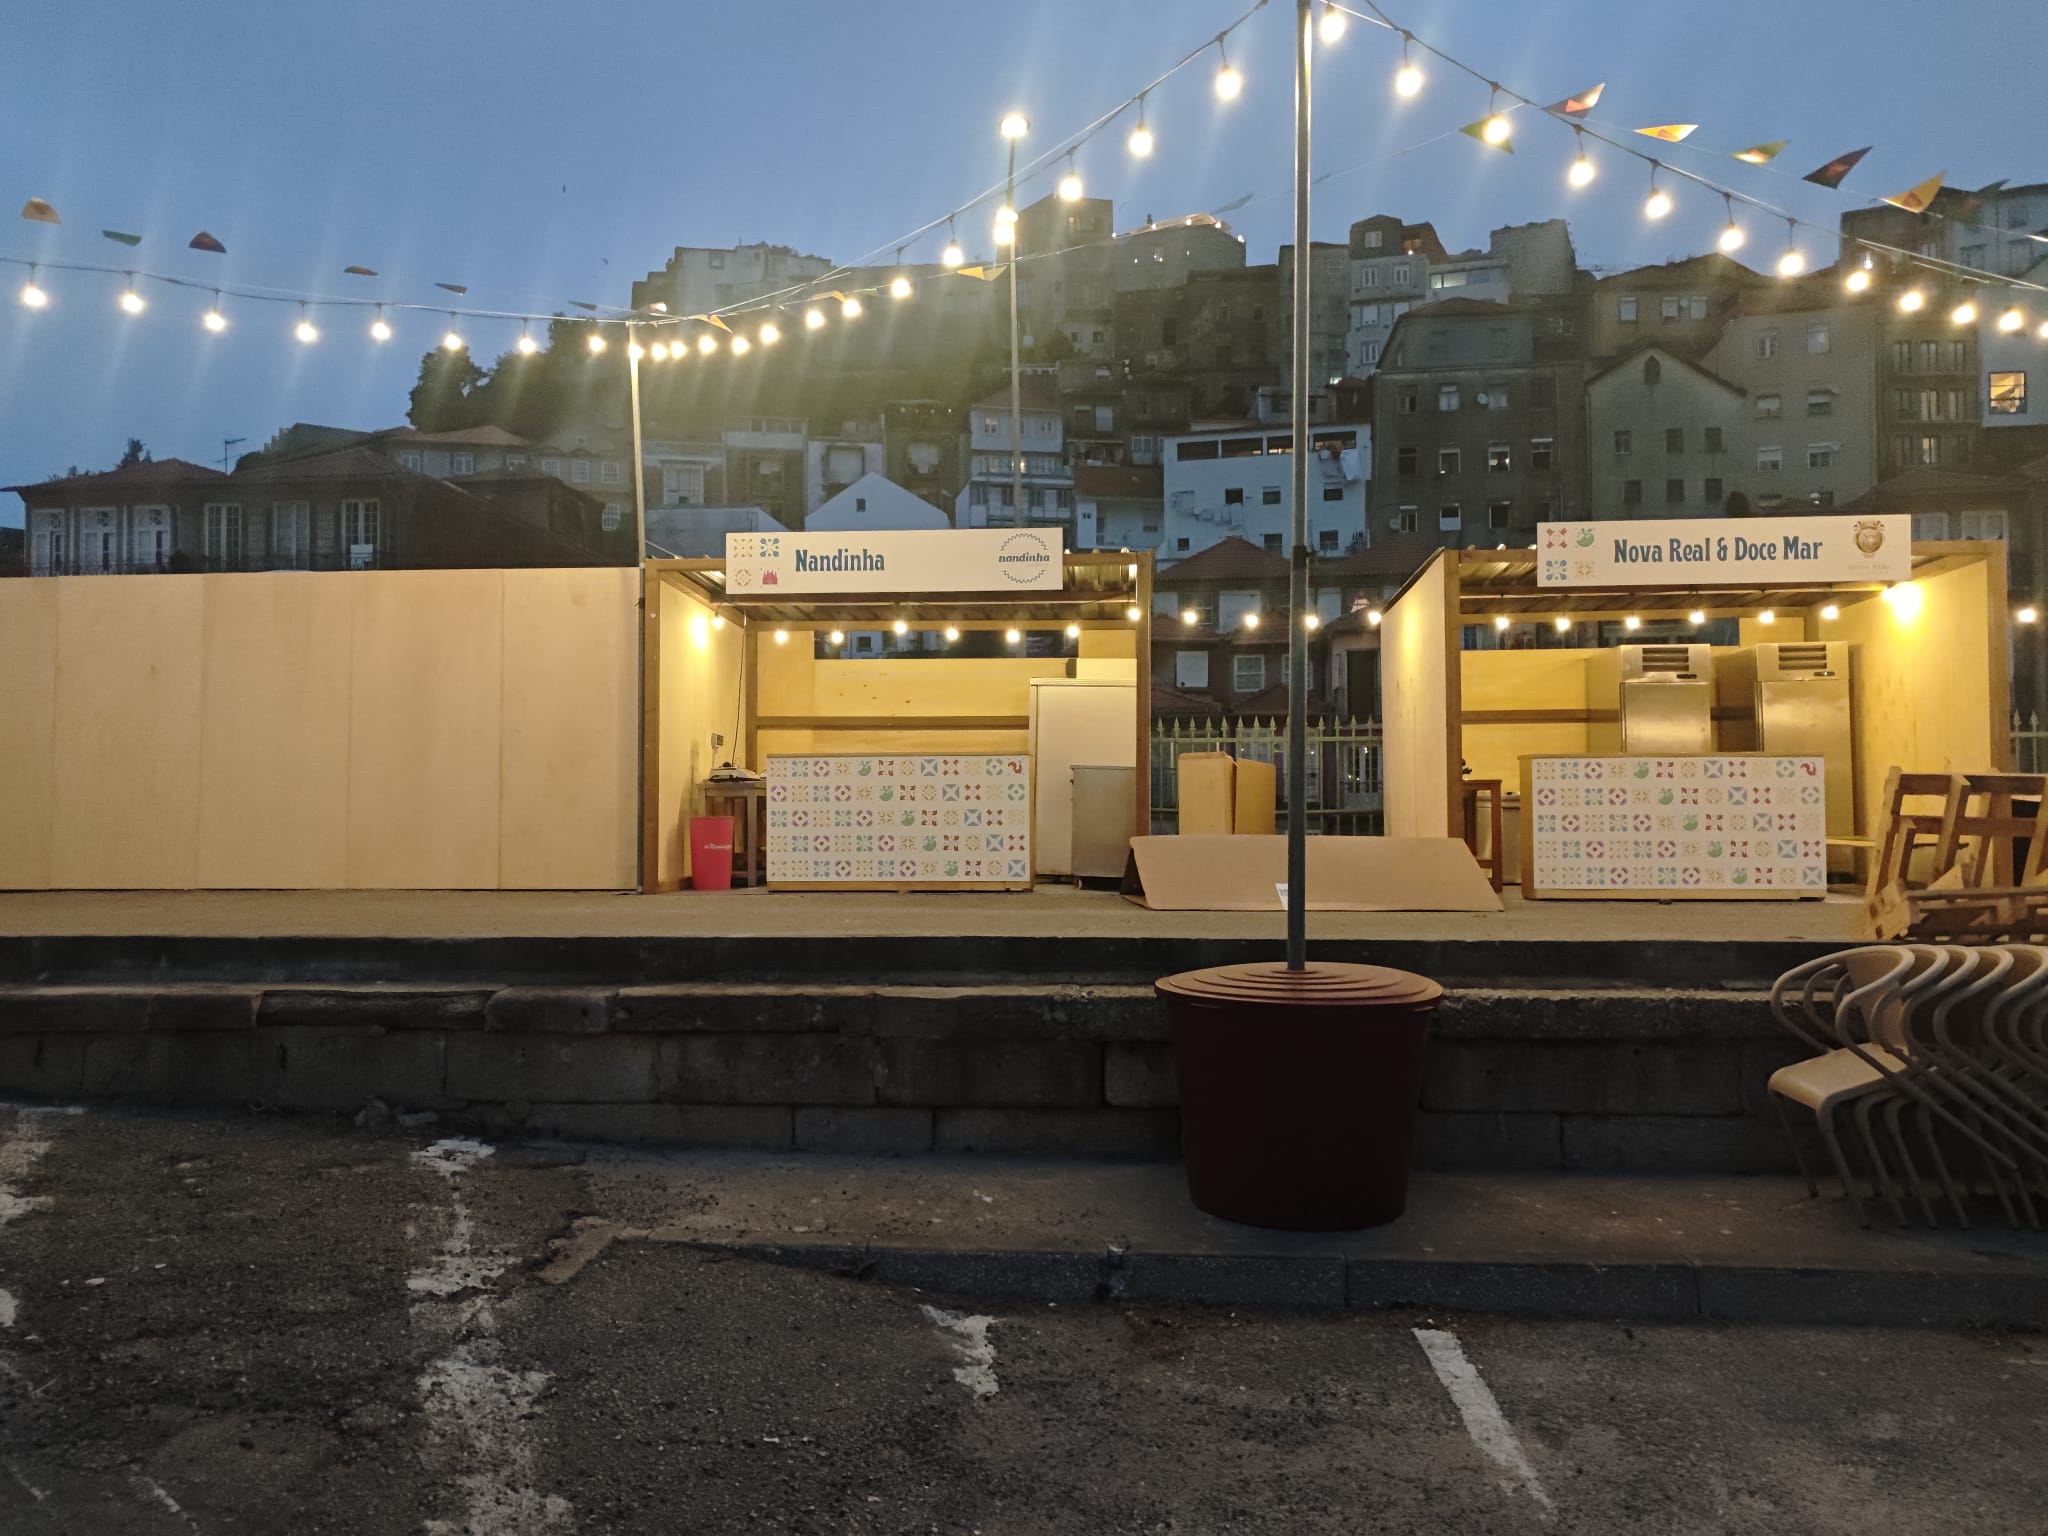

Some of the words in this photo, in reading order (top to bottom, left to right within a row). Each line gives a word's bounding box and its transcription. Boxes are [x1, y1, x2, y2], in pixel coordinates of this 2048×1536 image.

[795, 548, 885, 572] Nandinha
[998, 552, 1050, 563] nandinha
[1614, 539, 1663, 564] Nova
[1669, 537, 1711, 563] Real
[1716, 536, 1729, 562] &
[1734, 536, 1777, 561] Doce
[1783, 535, 1823, 560] Mar
